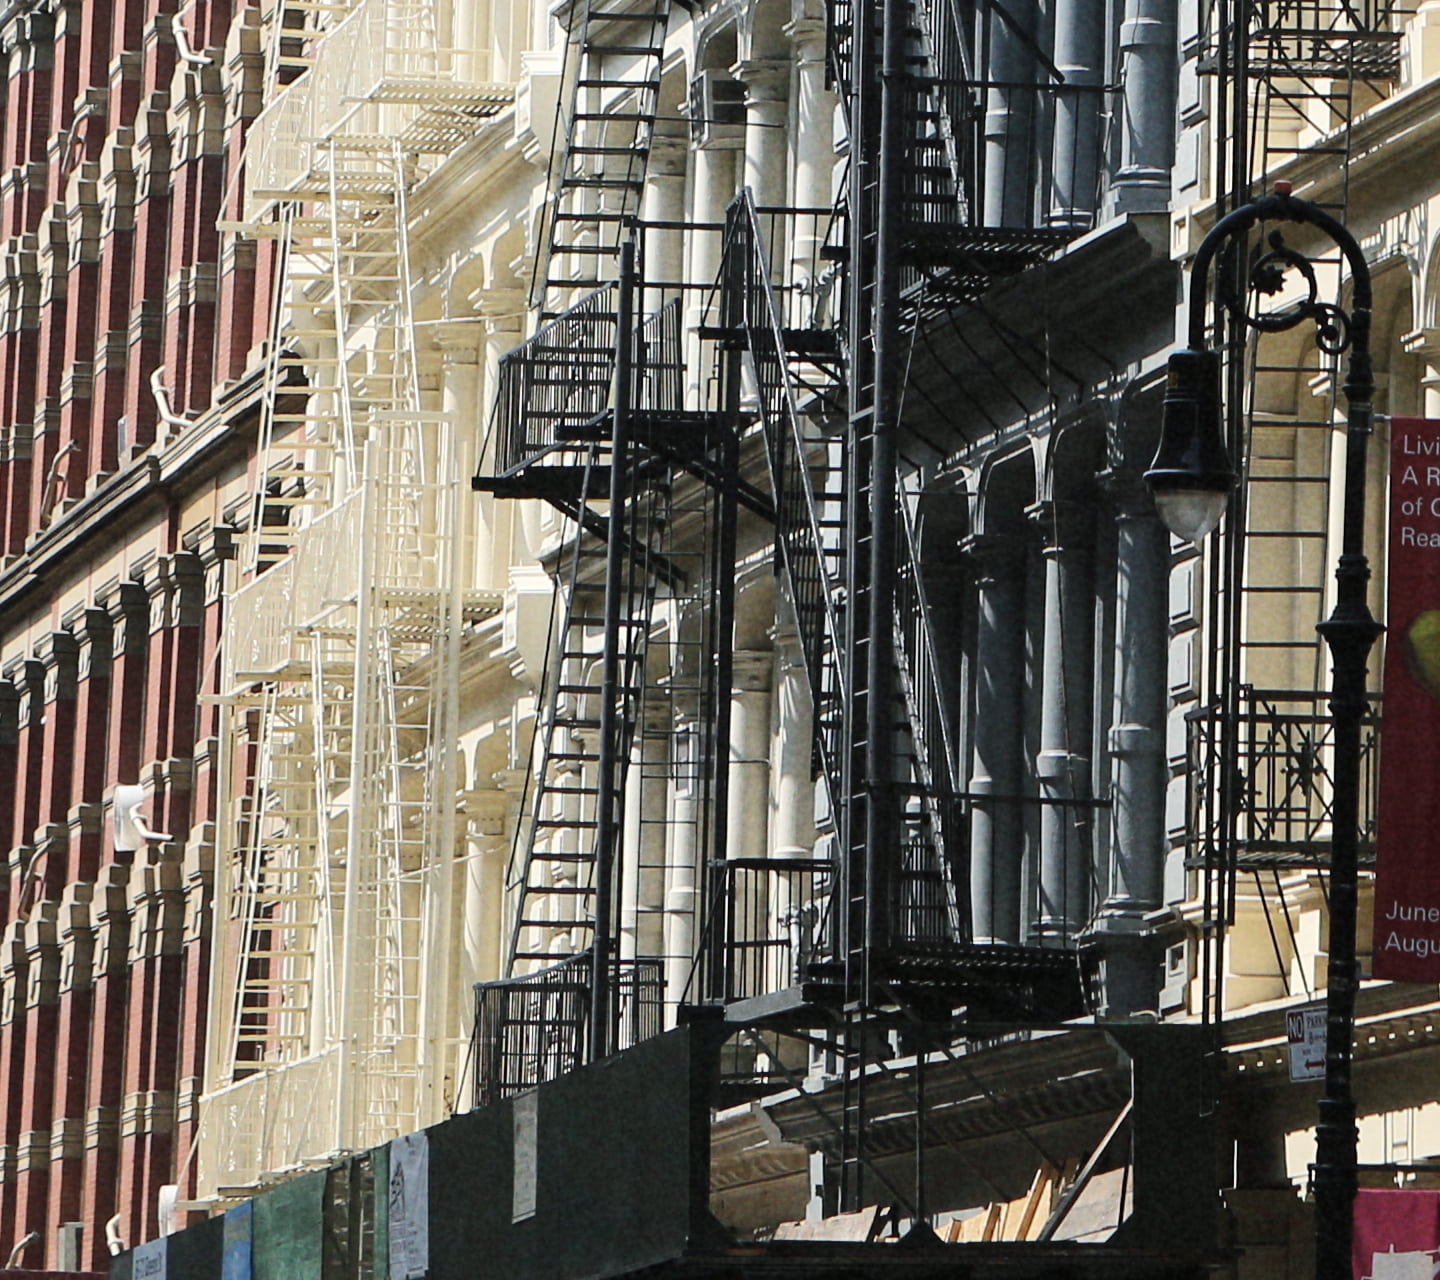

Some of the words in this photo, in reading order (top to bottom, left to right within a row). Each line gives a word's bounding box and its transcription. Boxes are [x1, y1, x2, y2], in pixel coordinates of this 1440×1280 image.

[1401, 466, 1419, 486] A
[1401, 497, 1423, 517] of
[1385, 900, 1440, 923] June
[1289, 1015, 1303, 1039] NO
